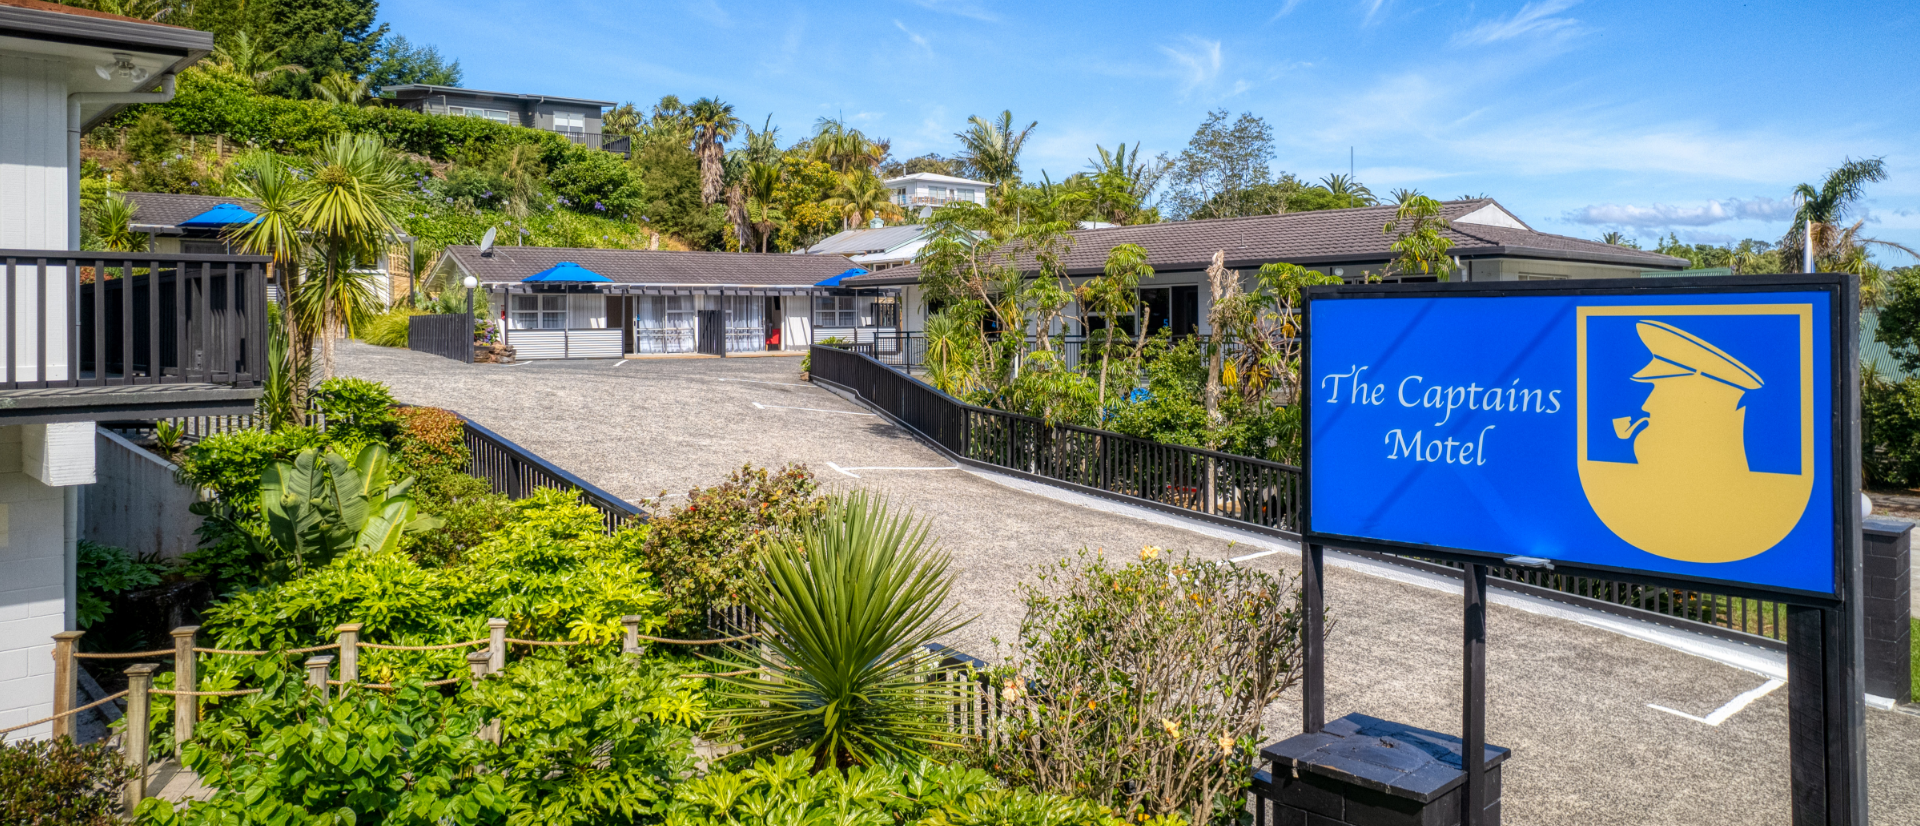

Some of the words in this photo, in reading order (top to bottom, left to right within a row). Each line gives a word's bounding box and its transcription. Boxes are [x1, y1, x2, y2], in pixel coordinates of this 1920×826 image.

[1163, 318, 1169, 327] 5
[1321, 364, 1385, 405] The
[1398, 375, 1562, 427] Captains
[1384, 425, 1496, 466] Motel
